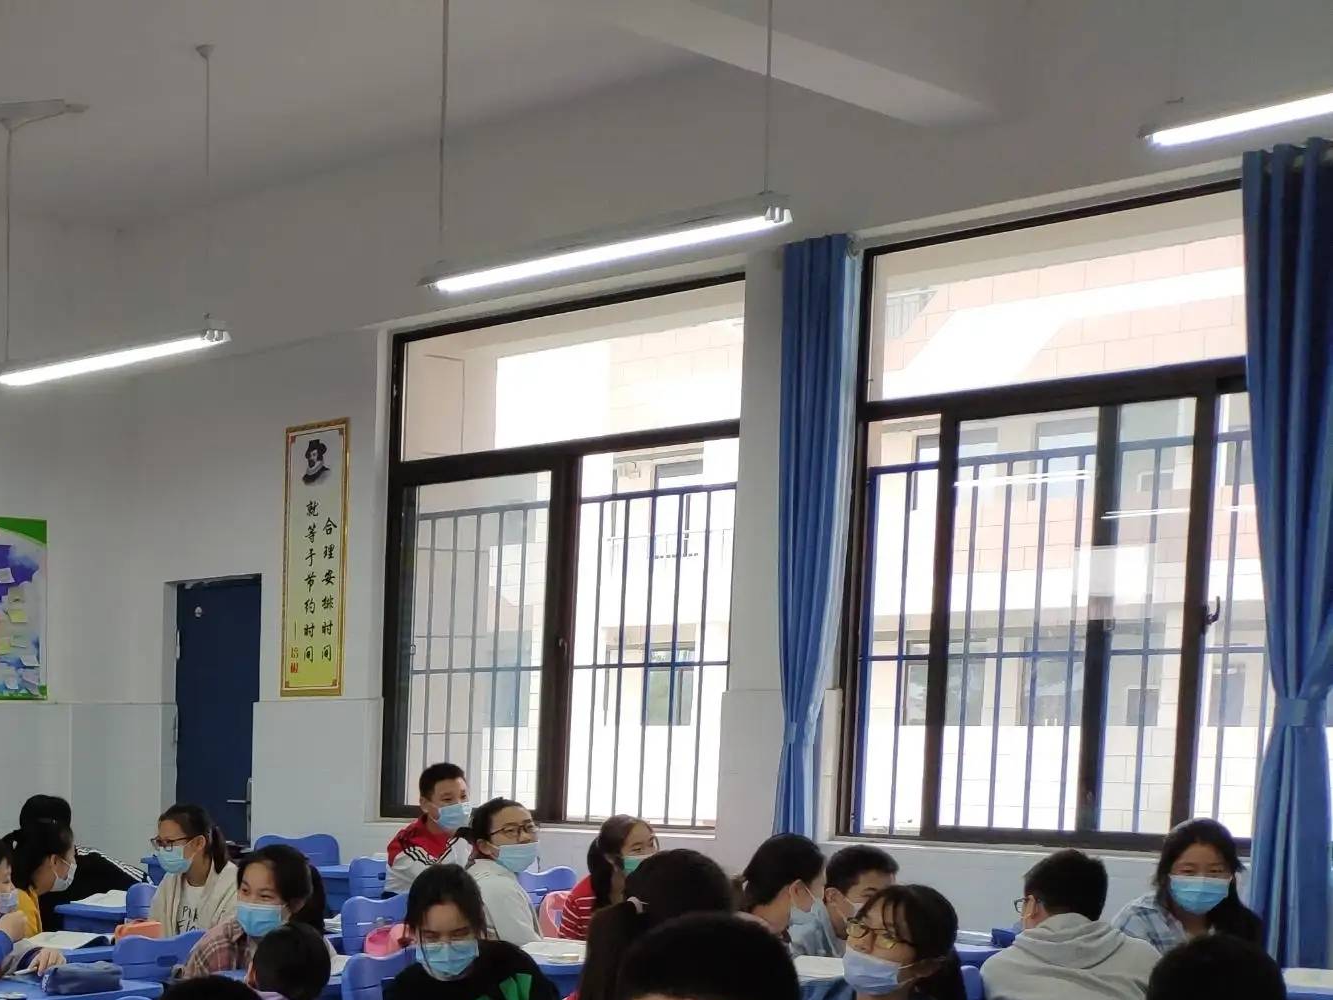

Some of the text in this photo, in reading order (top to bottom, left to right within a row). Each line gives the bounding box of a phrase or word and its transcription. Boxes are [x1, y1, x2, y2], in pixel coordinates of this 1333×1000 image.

[303, 500, 320, 664] 就等于节约时间
[321, 516, 337, 664] 合理安排时间
